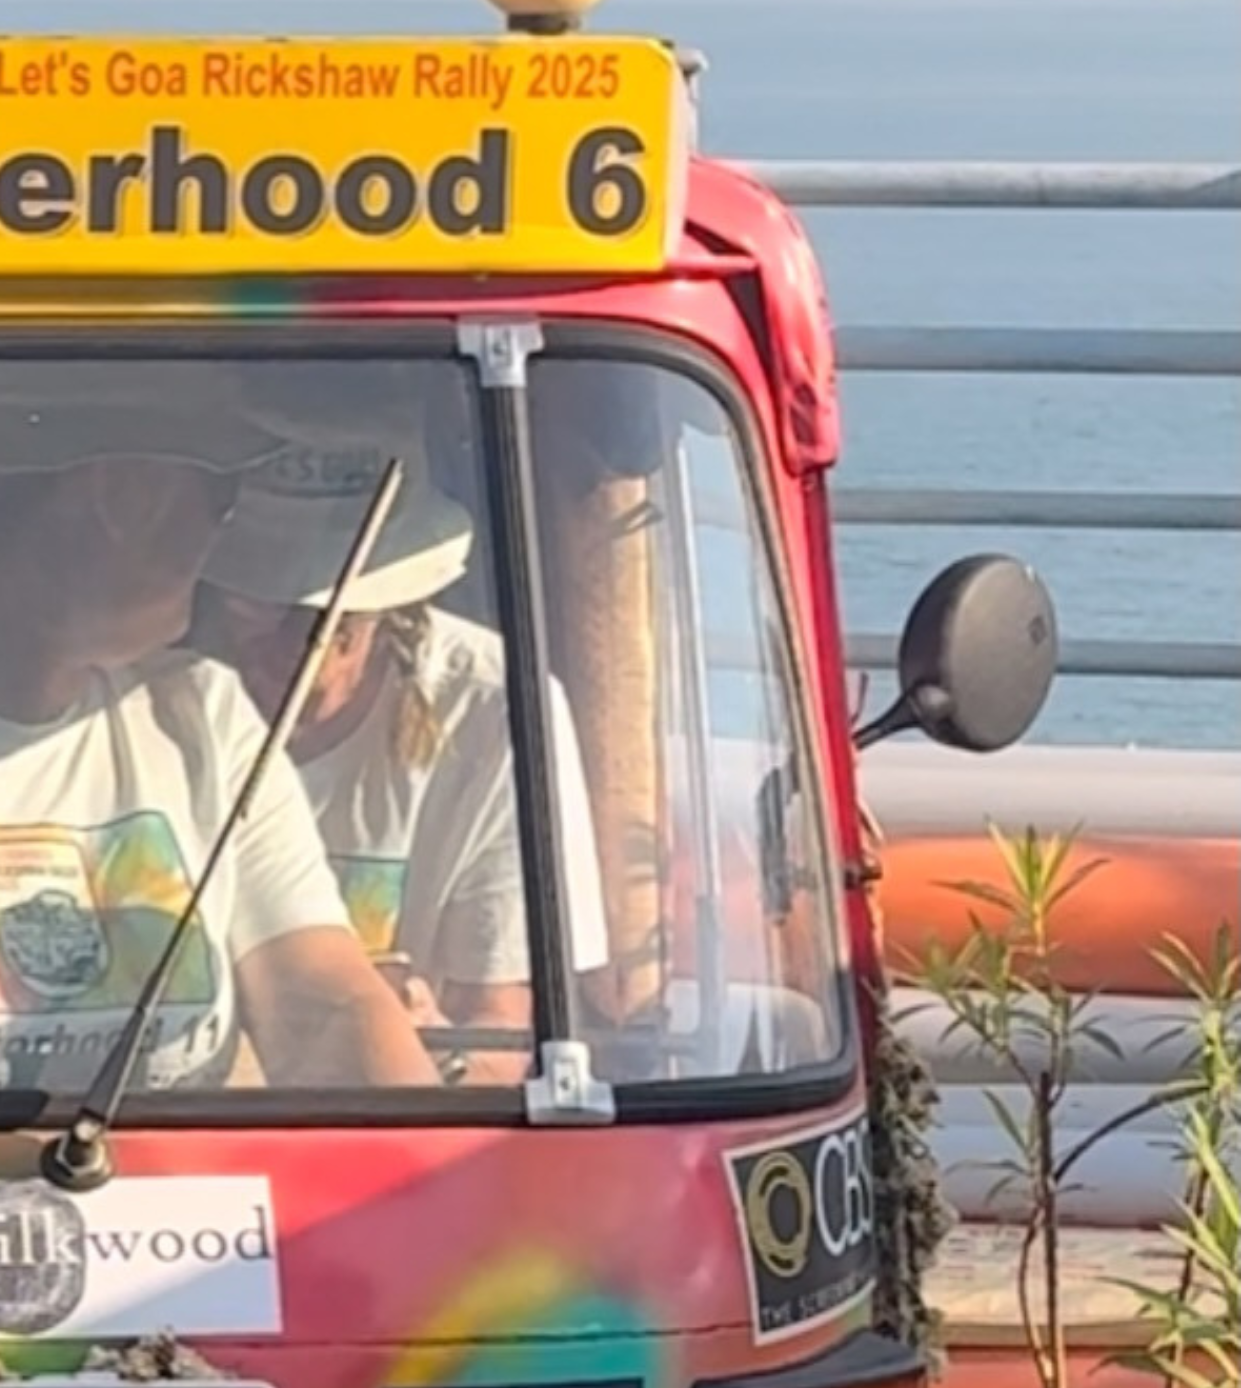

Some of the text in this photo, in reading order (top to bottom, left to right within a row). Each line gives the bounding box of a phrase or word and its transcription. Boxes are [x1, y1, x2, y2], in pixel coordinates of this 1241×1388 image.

[106, 51, 187, 96] Goa
[202, 51, 400, 98] Rickshaw
[413, 53, 514, 111] Rally
[526, 54, 620, 98] 2025
[566, 126, 647, 236] 6
